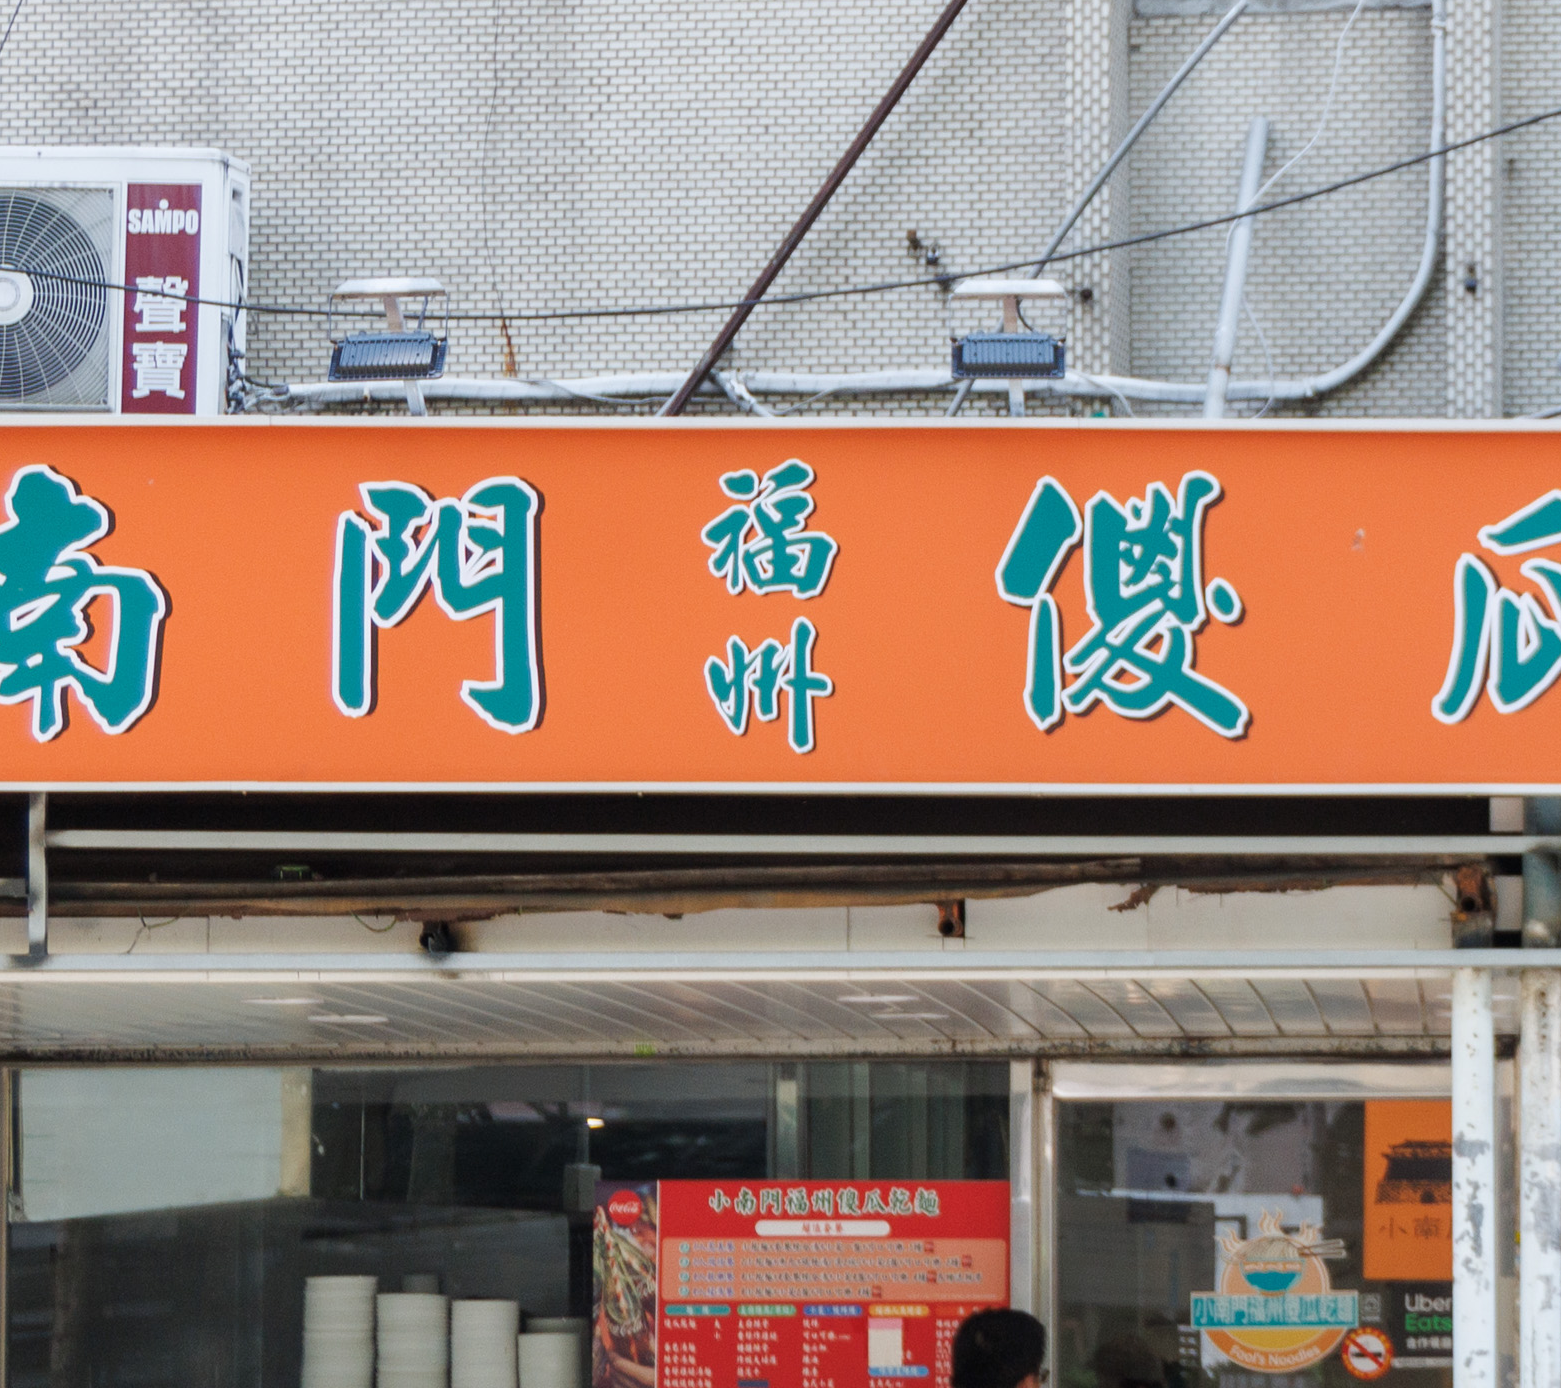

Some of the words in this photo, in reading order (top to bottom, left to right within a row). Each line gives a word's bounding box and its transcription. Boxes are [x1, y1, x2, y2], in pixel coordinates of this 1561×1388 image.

[127, 204, 199, 235] SAMPO
[132, 275, 189, 400] 聲寶
[697, 457, 840, 754] 福州
[708, 1186, 941, 1217] 小南門福州傻瓜乾麵
[1378, 1215, 1452, 1240] 小南
[1404, 1312, 1452, 1332] Eats
